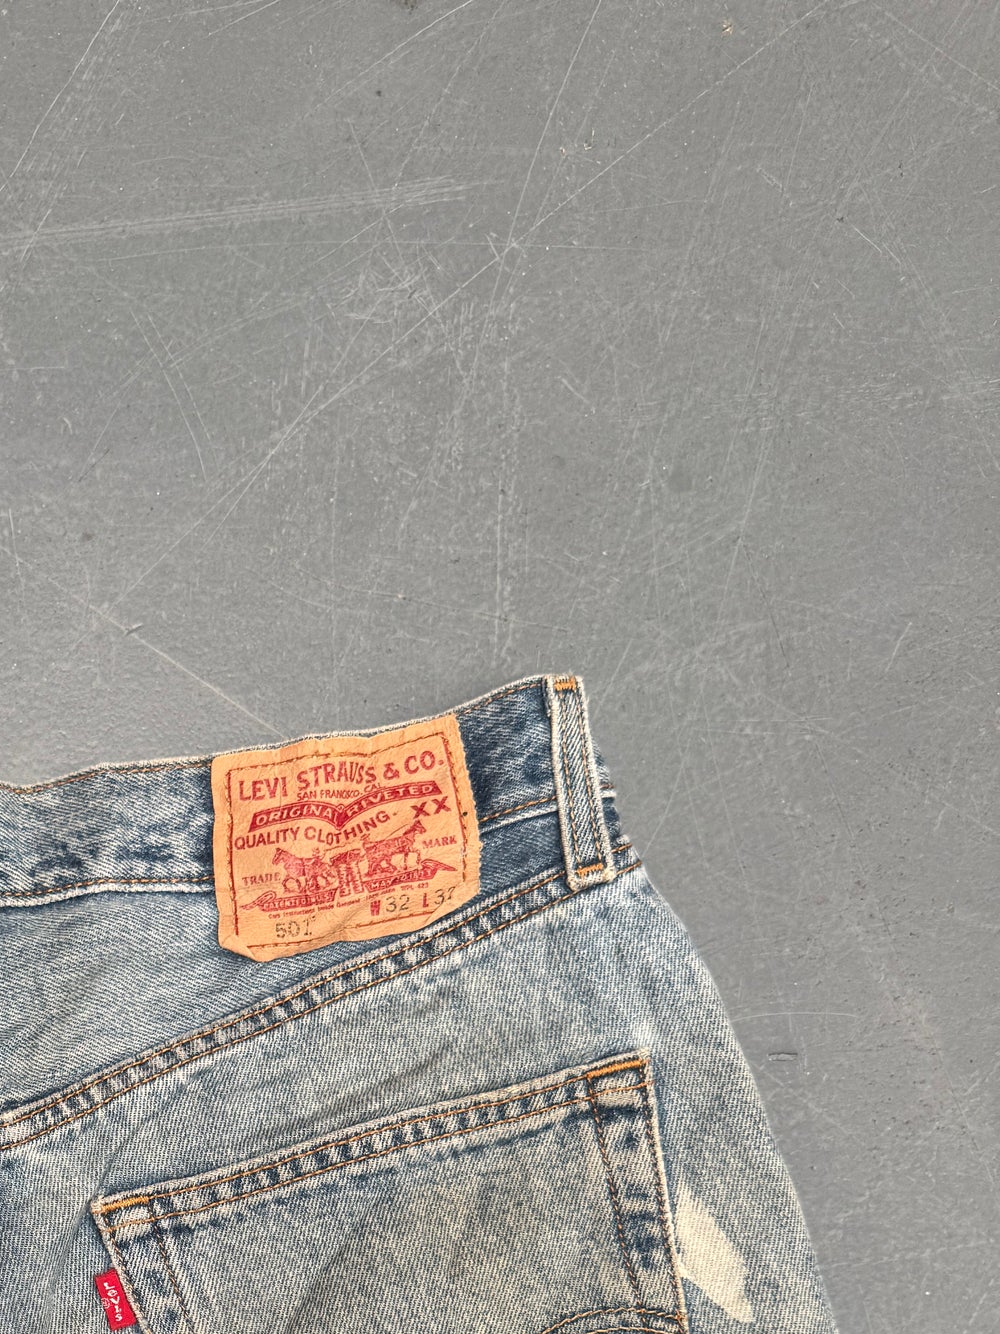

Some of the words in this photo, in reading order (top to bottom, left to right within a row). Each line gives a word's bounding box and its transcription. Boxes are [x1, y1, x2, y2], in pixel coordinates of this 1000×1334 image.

[239, 776, 288, 801] LEVI
[297, 760, 377, 791] STRAUSS
[383, 762, 400, 780] &
[404, 750, 444, 775] CO.
[297, 789, 317, 801] SAN
[346, 785, 434, 817] RIVETED
[234, 827, 300, 850] QUALITY
[423, 835, 456, 849] MARK
[242, 871, 281, 886] TRADE
[386, 894, 410, 912] 32
